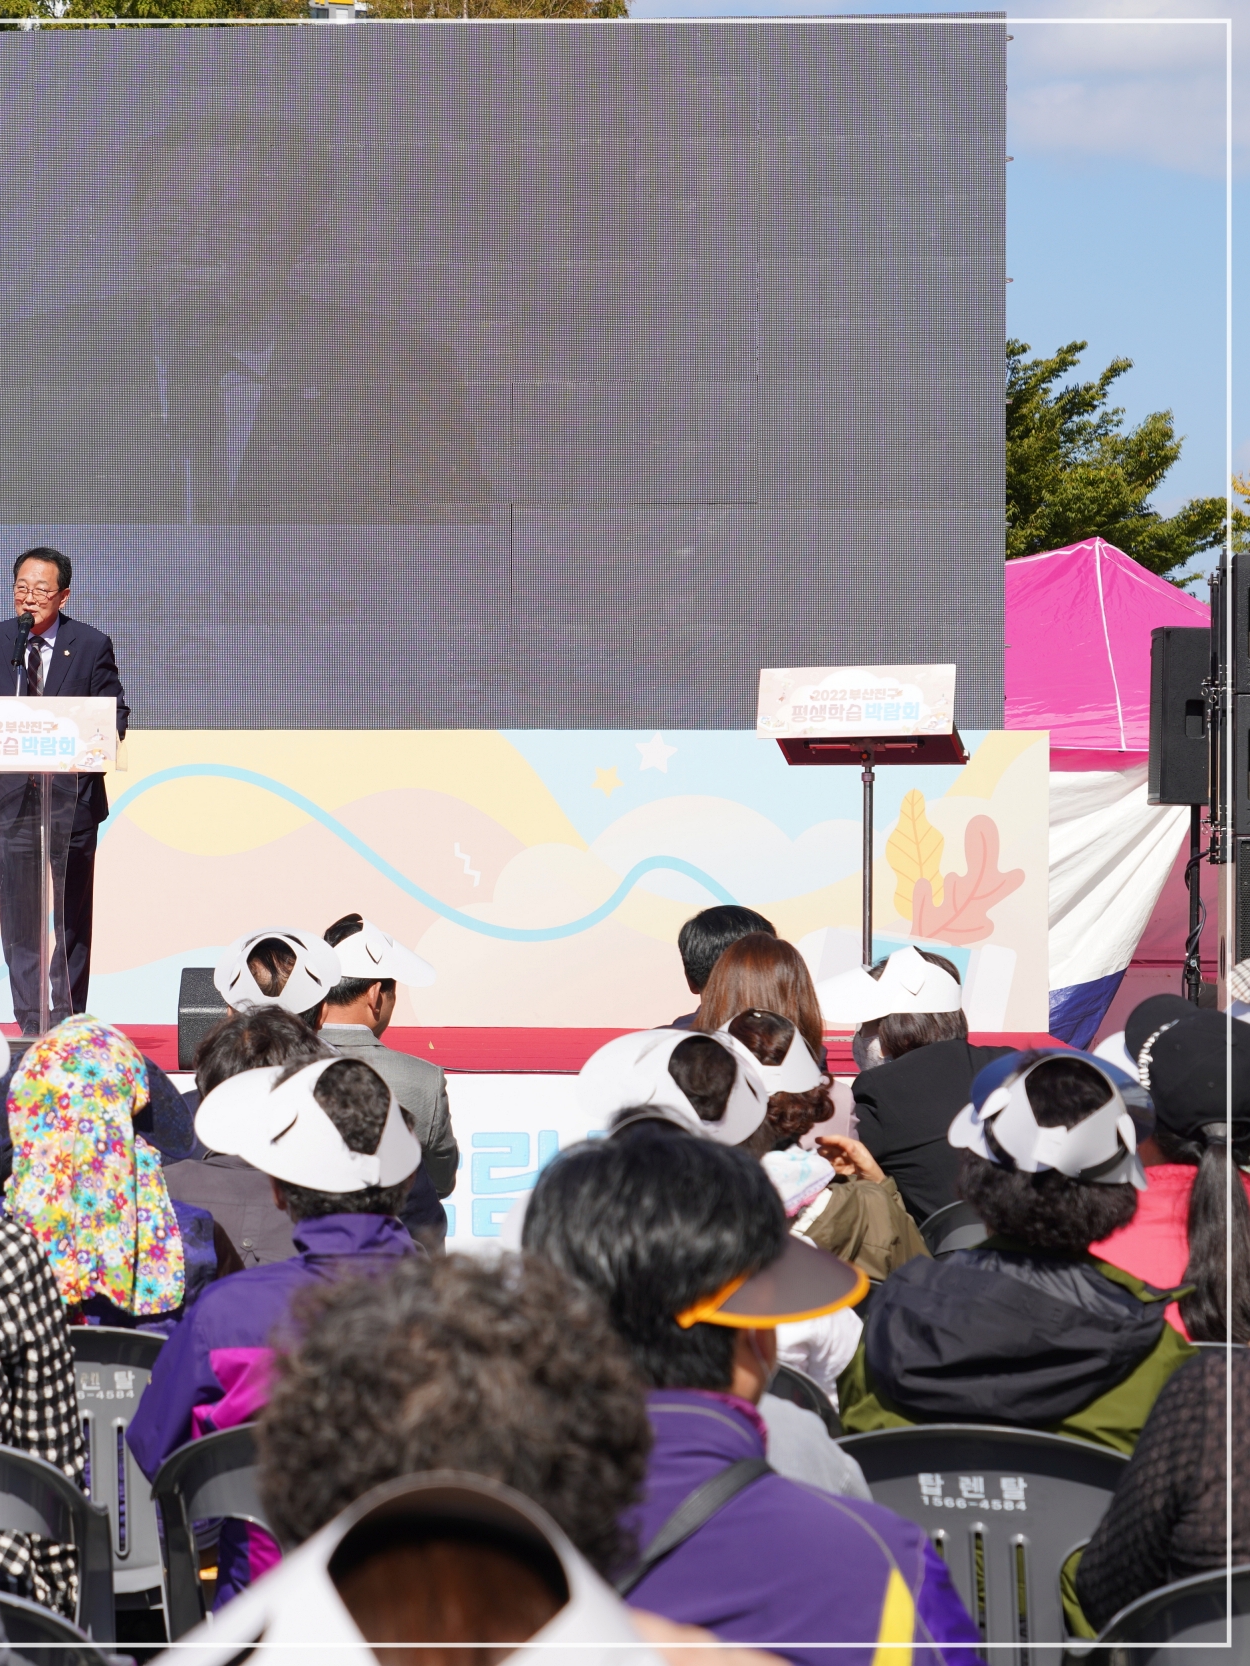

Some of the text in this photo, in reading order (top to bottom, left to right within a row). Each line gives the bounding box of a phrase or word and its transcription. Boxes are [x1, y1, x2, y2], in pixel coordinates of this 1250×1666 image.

[811, 688, 899, 702] 2022 부산진구
[791, 702, 920, 723] 평생학습 박람회
[5, 720, 56, 734] 부산진구
[21, 736, 76, 757] 박람회
